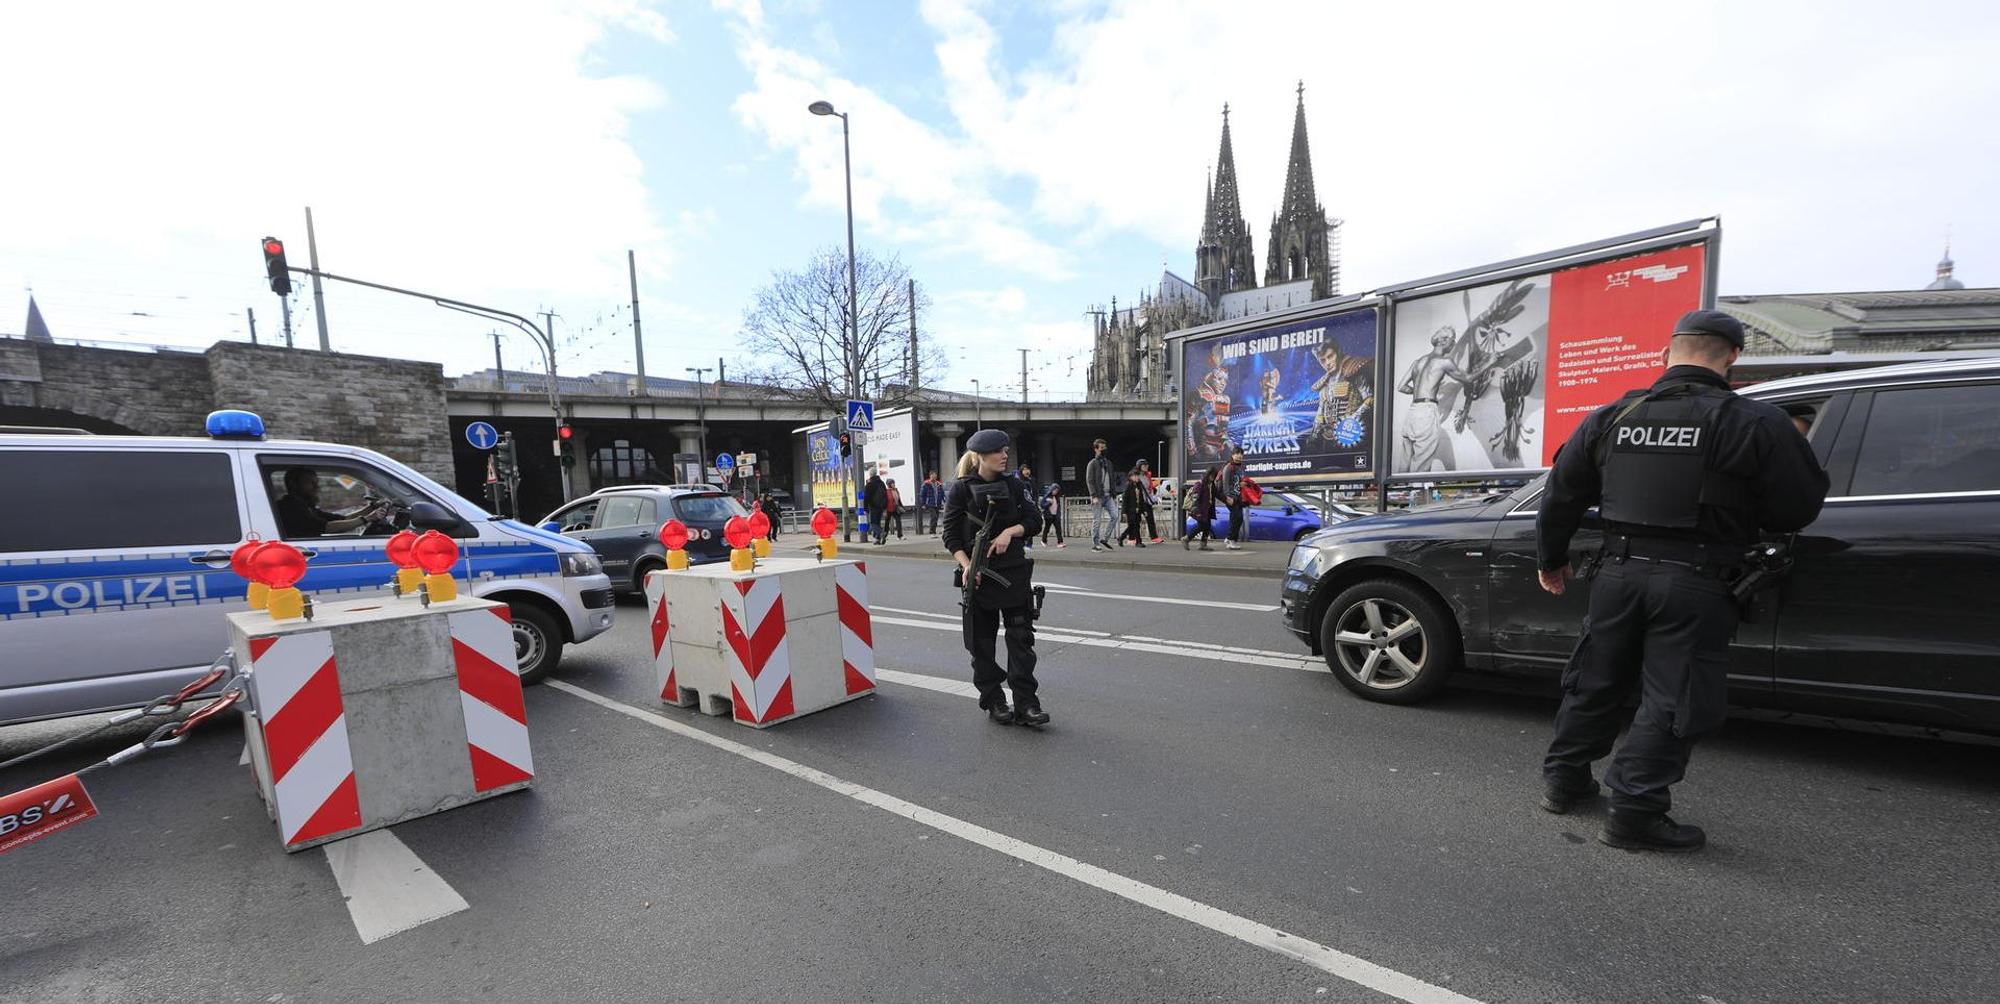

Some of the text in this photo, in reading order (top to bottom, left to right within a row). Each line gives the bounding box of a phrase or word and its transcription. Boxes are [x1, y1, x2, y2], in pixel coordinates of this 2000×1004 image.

[1222, 327, 1326, 359] WIR SIND BEREIT
[1560, 335, 1623, 349] Schausammlung
[1560, 343, 1637, 359] Leben und Werk des
[1559, 358, 1596, 369] Dadaisten
[1597, 356, 1613, 364] und
[1558, 368, 1592, 379] Skulptur,
[1244, 420, 1296, 437] STARLIGHT
[1617, 426, 1701, 447] POLIZEI
[1241, 435, 1301, 455] EXPRESS
[17, 574, 207, 612] POLIZEI
